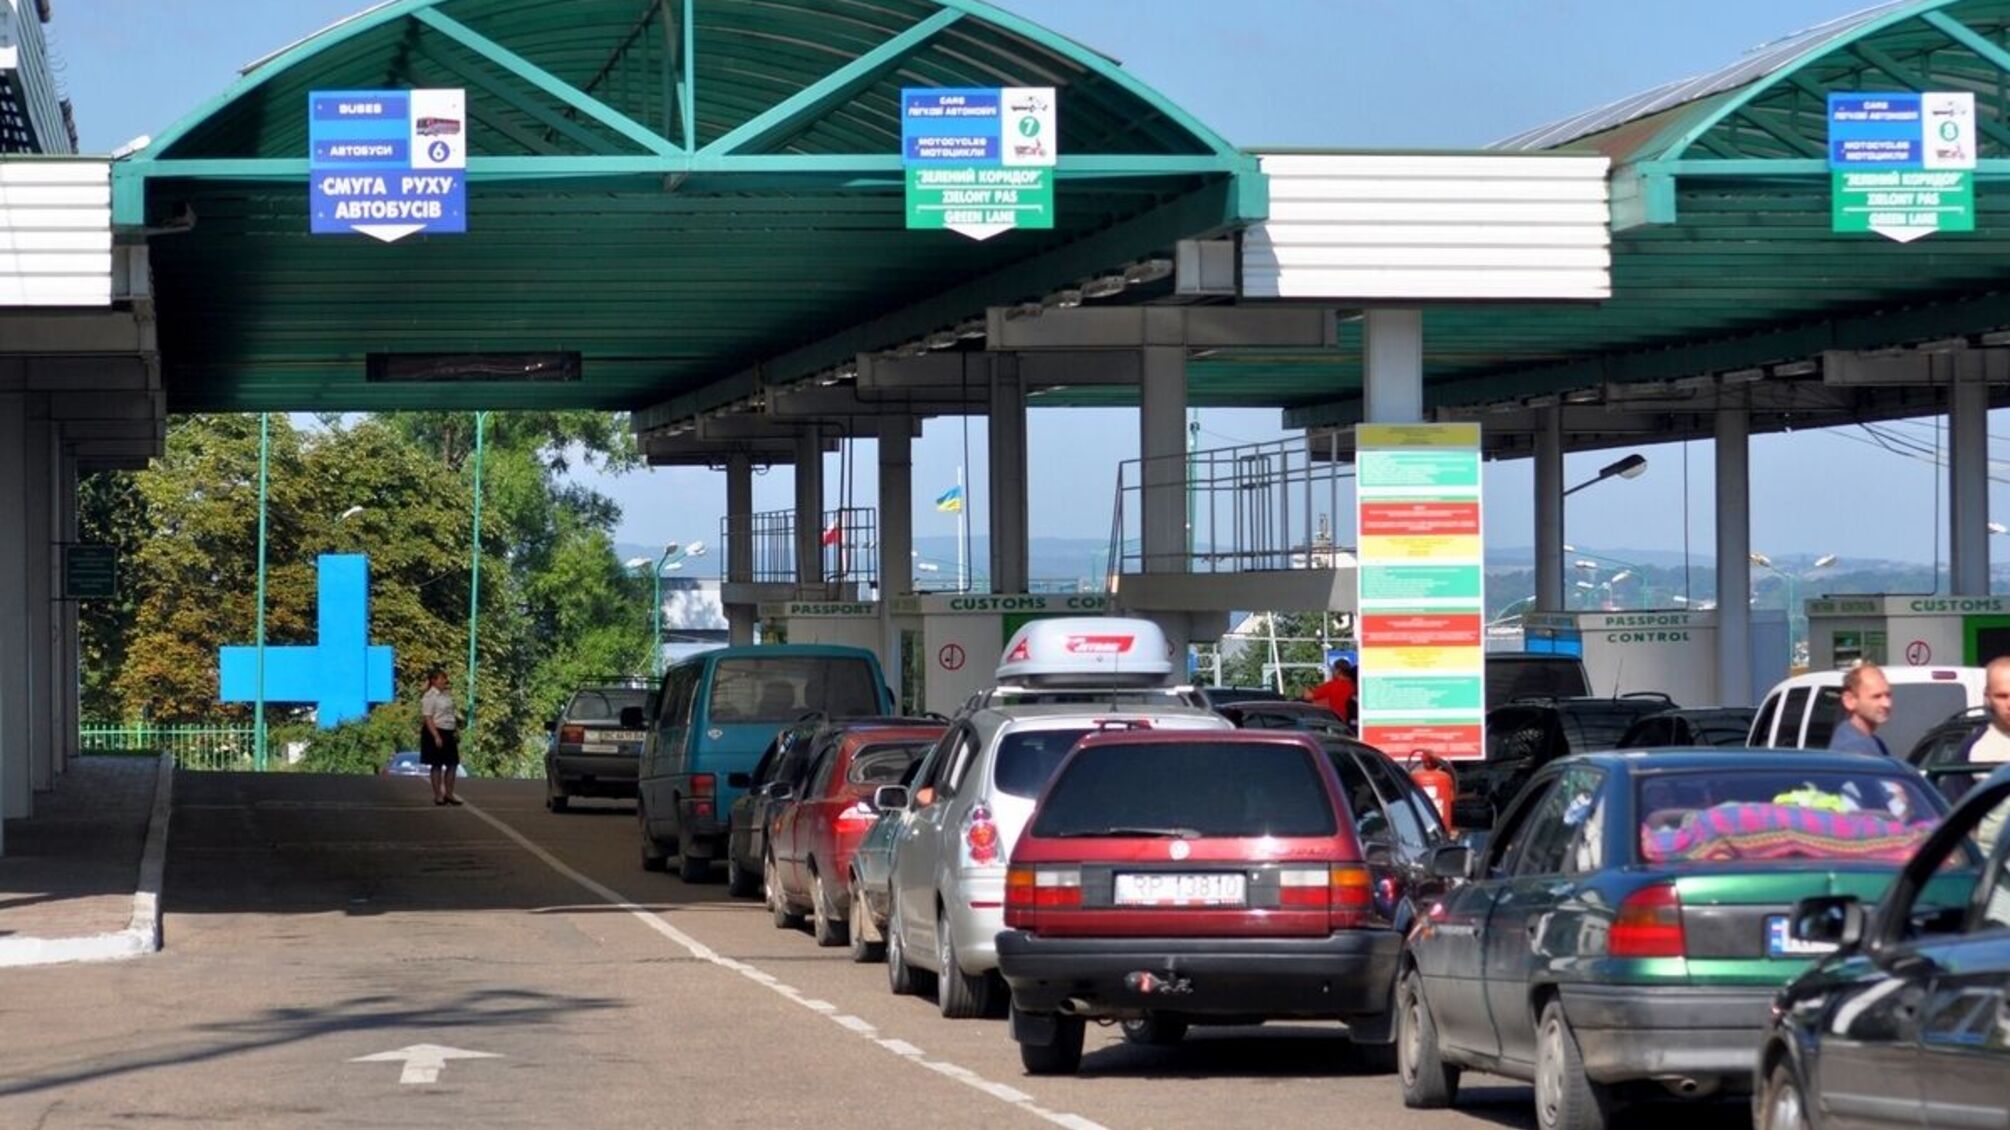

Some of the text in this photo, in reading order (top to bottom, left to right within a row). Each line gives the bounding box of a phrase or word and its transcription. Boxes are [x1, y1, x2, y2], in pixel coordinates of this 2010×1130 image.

[338, 103, 382, 114] BUSES
[1024, 118, 1034, 135] 7
[330, 145, 393, 156] АВТОБУСИ
[432, 143, 445, 159] 6
[323, 177, 453, 195] СМУГА РУХУ
[335, 201, 442, 219] АВТОБУСІВ
[944, 211, 983, 223] GREEN
[791, 604, 873, 615] PASSPORT
[951, 597, 1047, 610] CUSTOMS
[1910, 600, 2003, 612] CUSTOMS
[1605, 614, 1689, 626] PASSPORT
[1607, 631, 1690, 643] CONTROL
